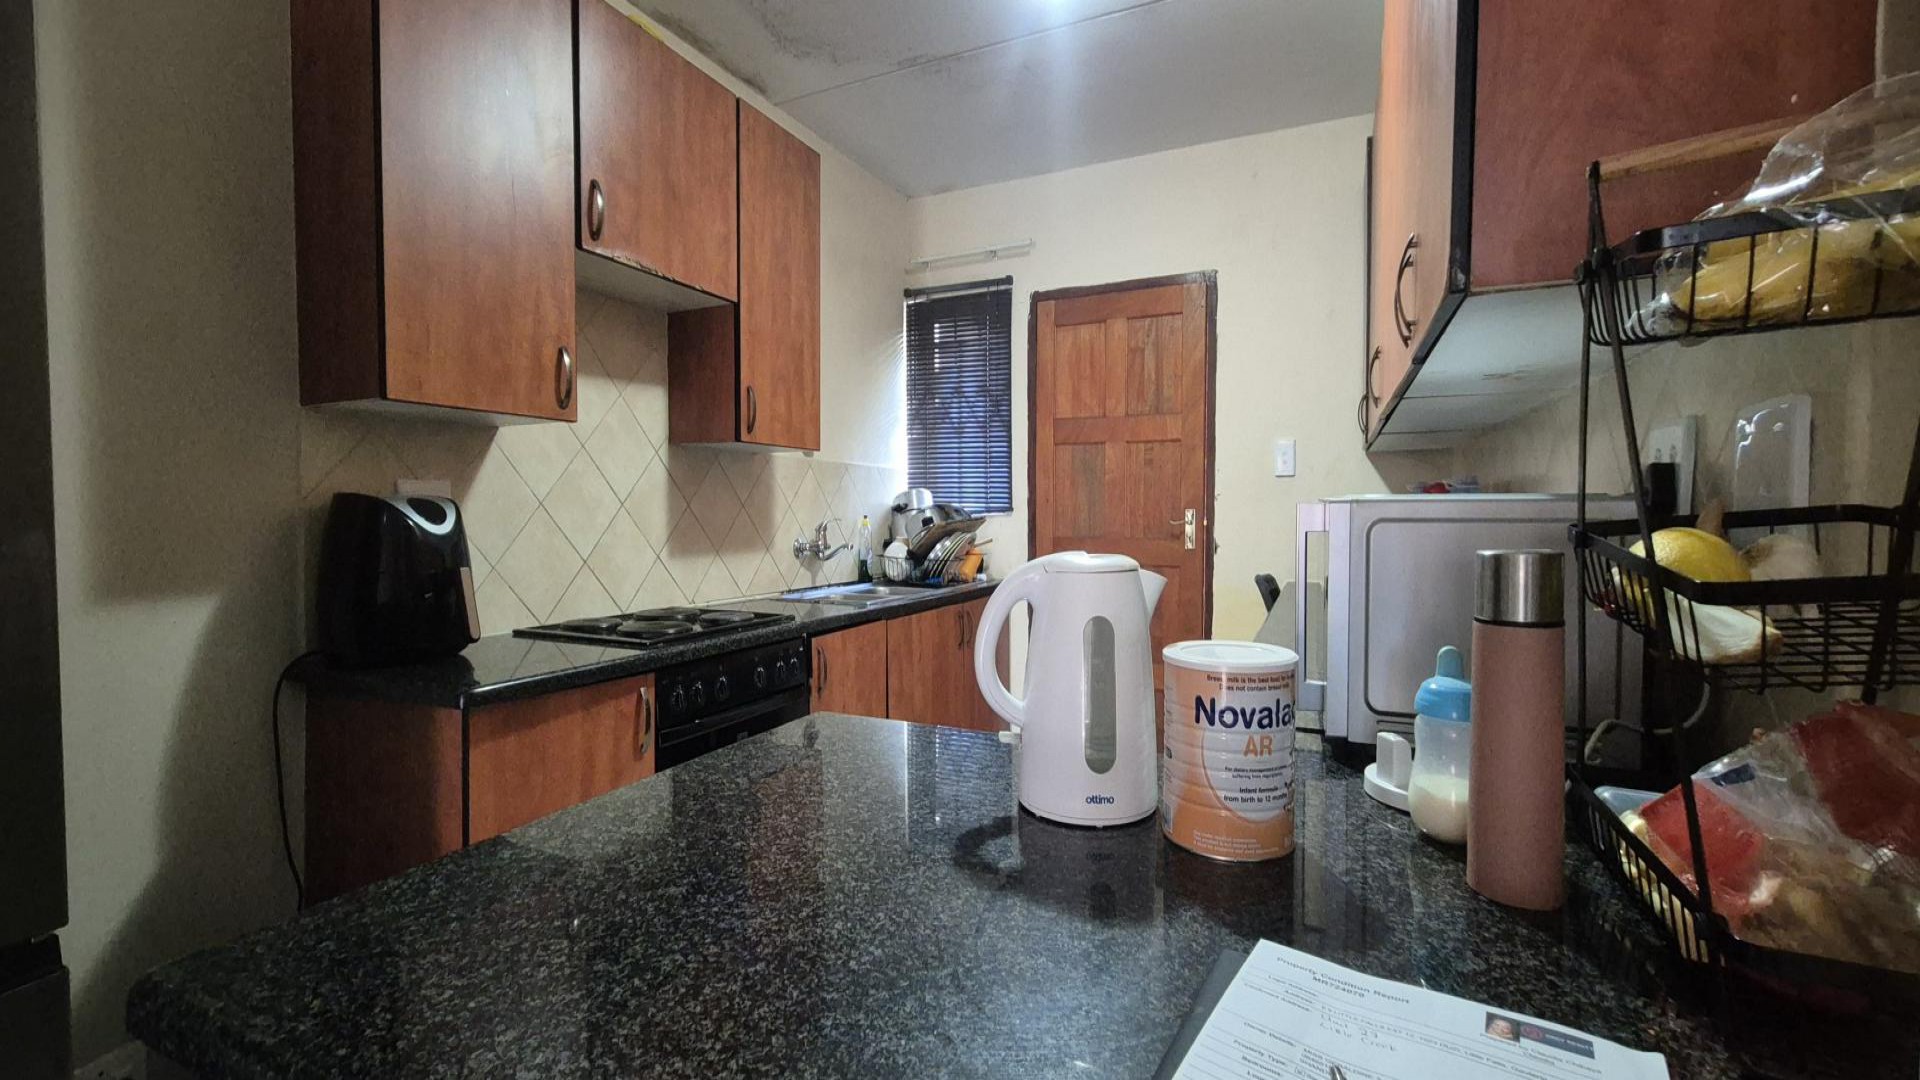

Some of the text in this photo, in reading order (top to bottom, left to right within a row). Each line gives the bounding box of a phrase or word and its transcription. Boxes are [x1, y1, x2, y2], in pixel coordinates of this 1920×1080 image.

[1206, 673, 1225, 682] Brea
[1194, 694, 1295, 730] Novala
[1243, 734, 1273, 757] AR
[1085, 794, 1115, 805] ottimo
[1223, 794, 1239, 803] from
[1240, 795, 1256, 803] birth
